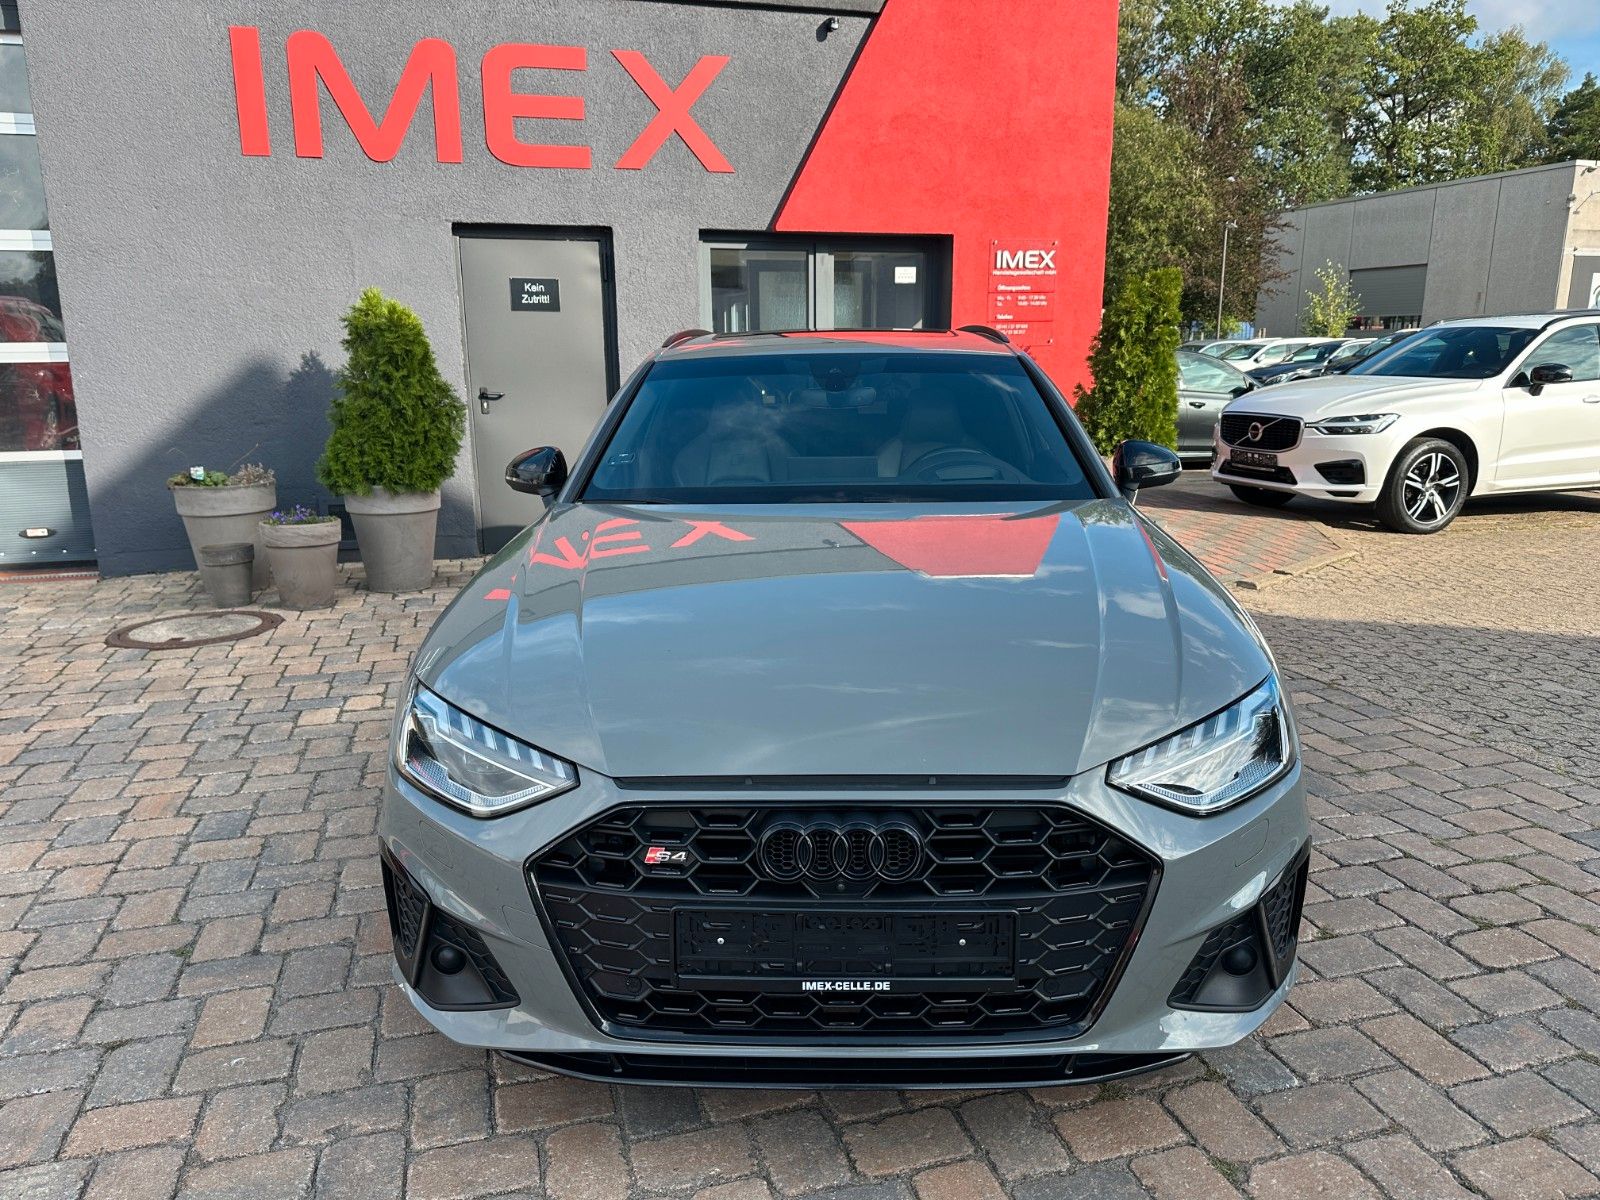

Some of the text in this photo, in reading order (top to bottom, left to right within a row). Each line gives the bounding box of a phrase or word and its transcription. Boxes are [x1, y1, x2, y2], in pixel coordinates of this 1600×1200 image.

[229, 26, 735, 173] IMEX
[996, 249, 1057, 270] IMEX
[523, 282, 545, 292] Kein
[655, 850, 687, 862] S4
[801, 981, 891, 991] IMEX-CELLE.DE
